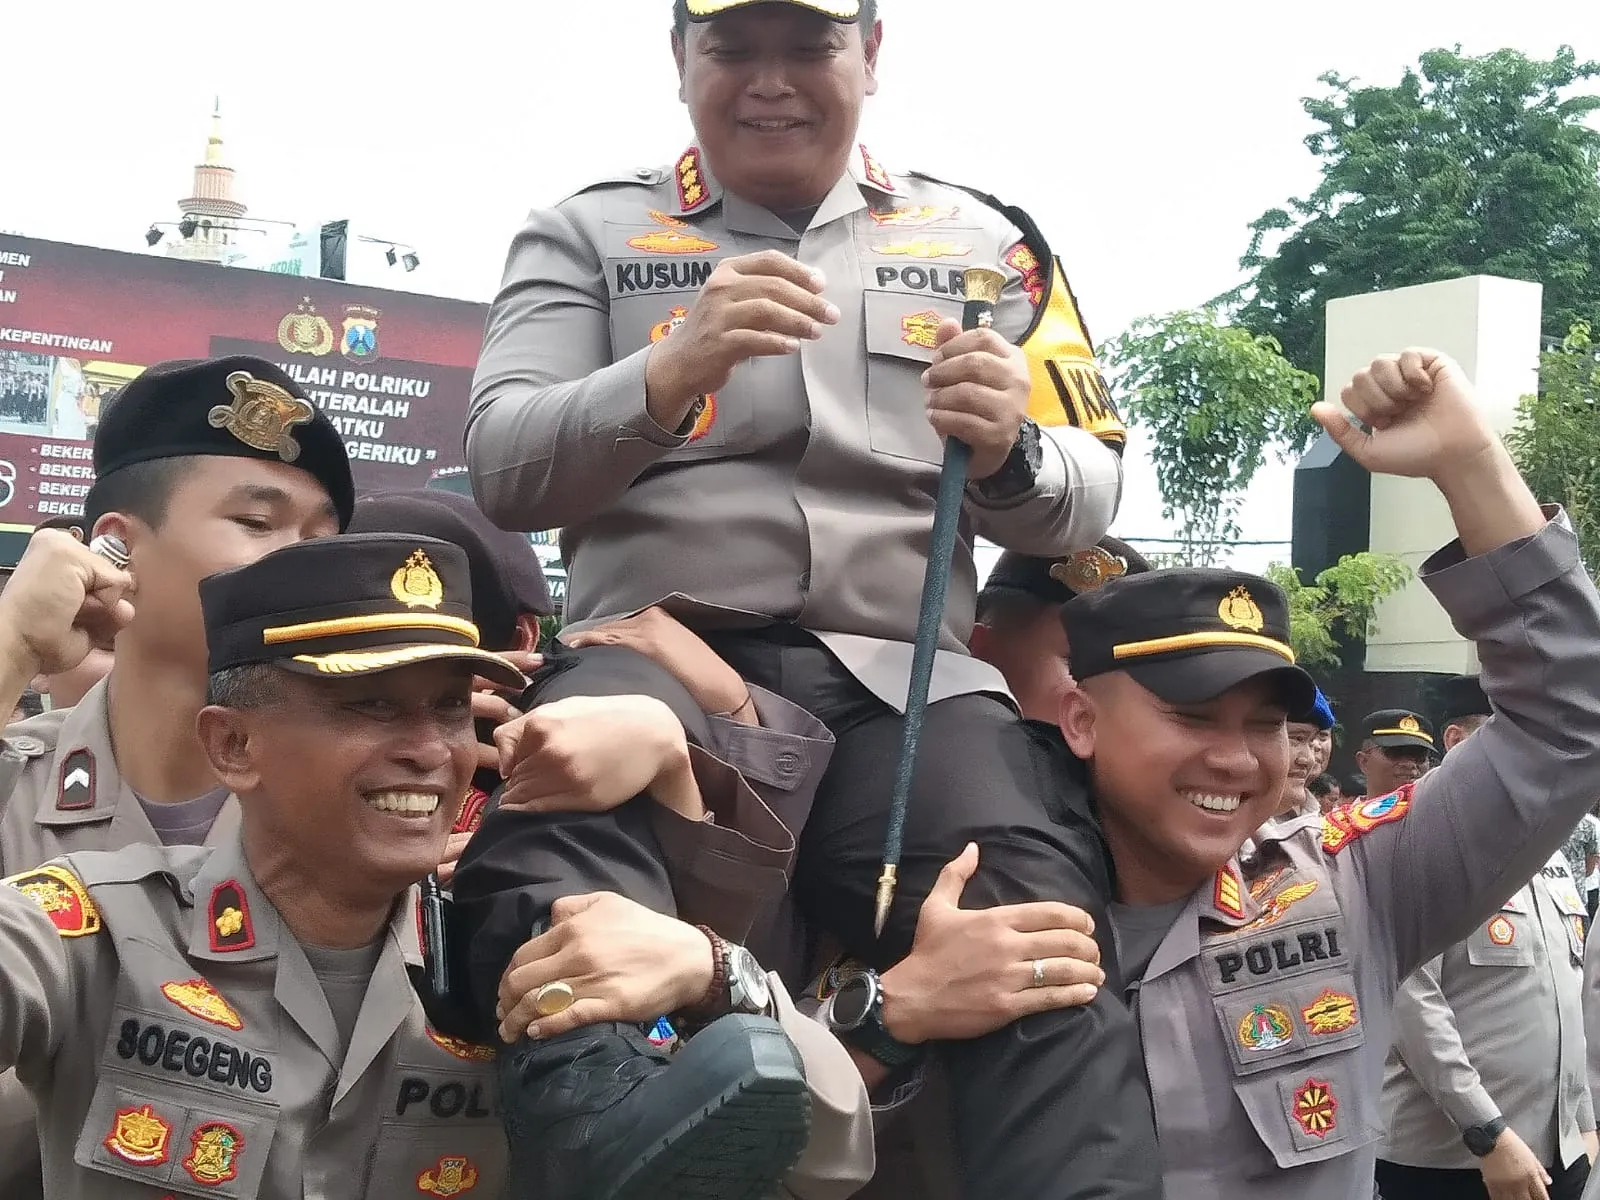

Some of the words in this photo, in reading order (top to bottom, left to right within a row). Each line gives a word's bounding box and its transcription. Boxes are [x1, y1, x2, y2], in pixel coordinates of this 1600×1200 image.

[0, 327, 113, 353] KEPENTINGAN
[275, 363, 337, 387] ULAH
[341, 371, 431, 397] POLRIKU
[328, 415, 385, 438] ATKU
[40, 443, 94, 460] BEKER
[346, 441, 421, 465] GERIKU
[1215, 928, 1342, 984] POLRI
[117, 1019, 273, 1093] SOEGENG
[396, 1076, 498, 1118] POL
